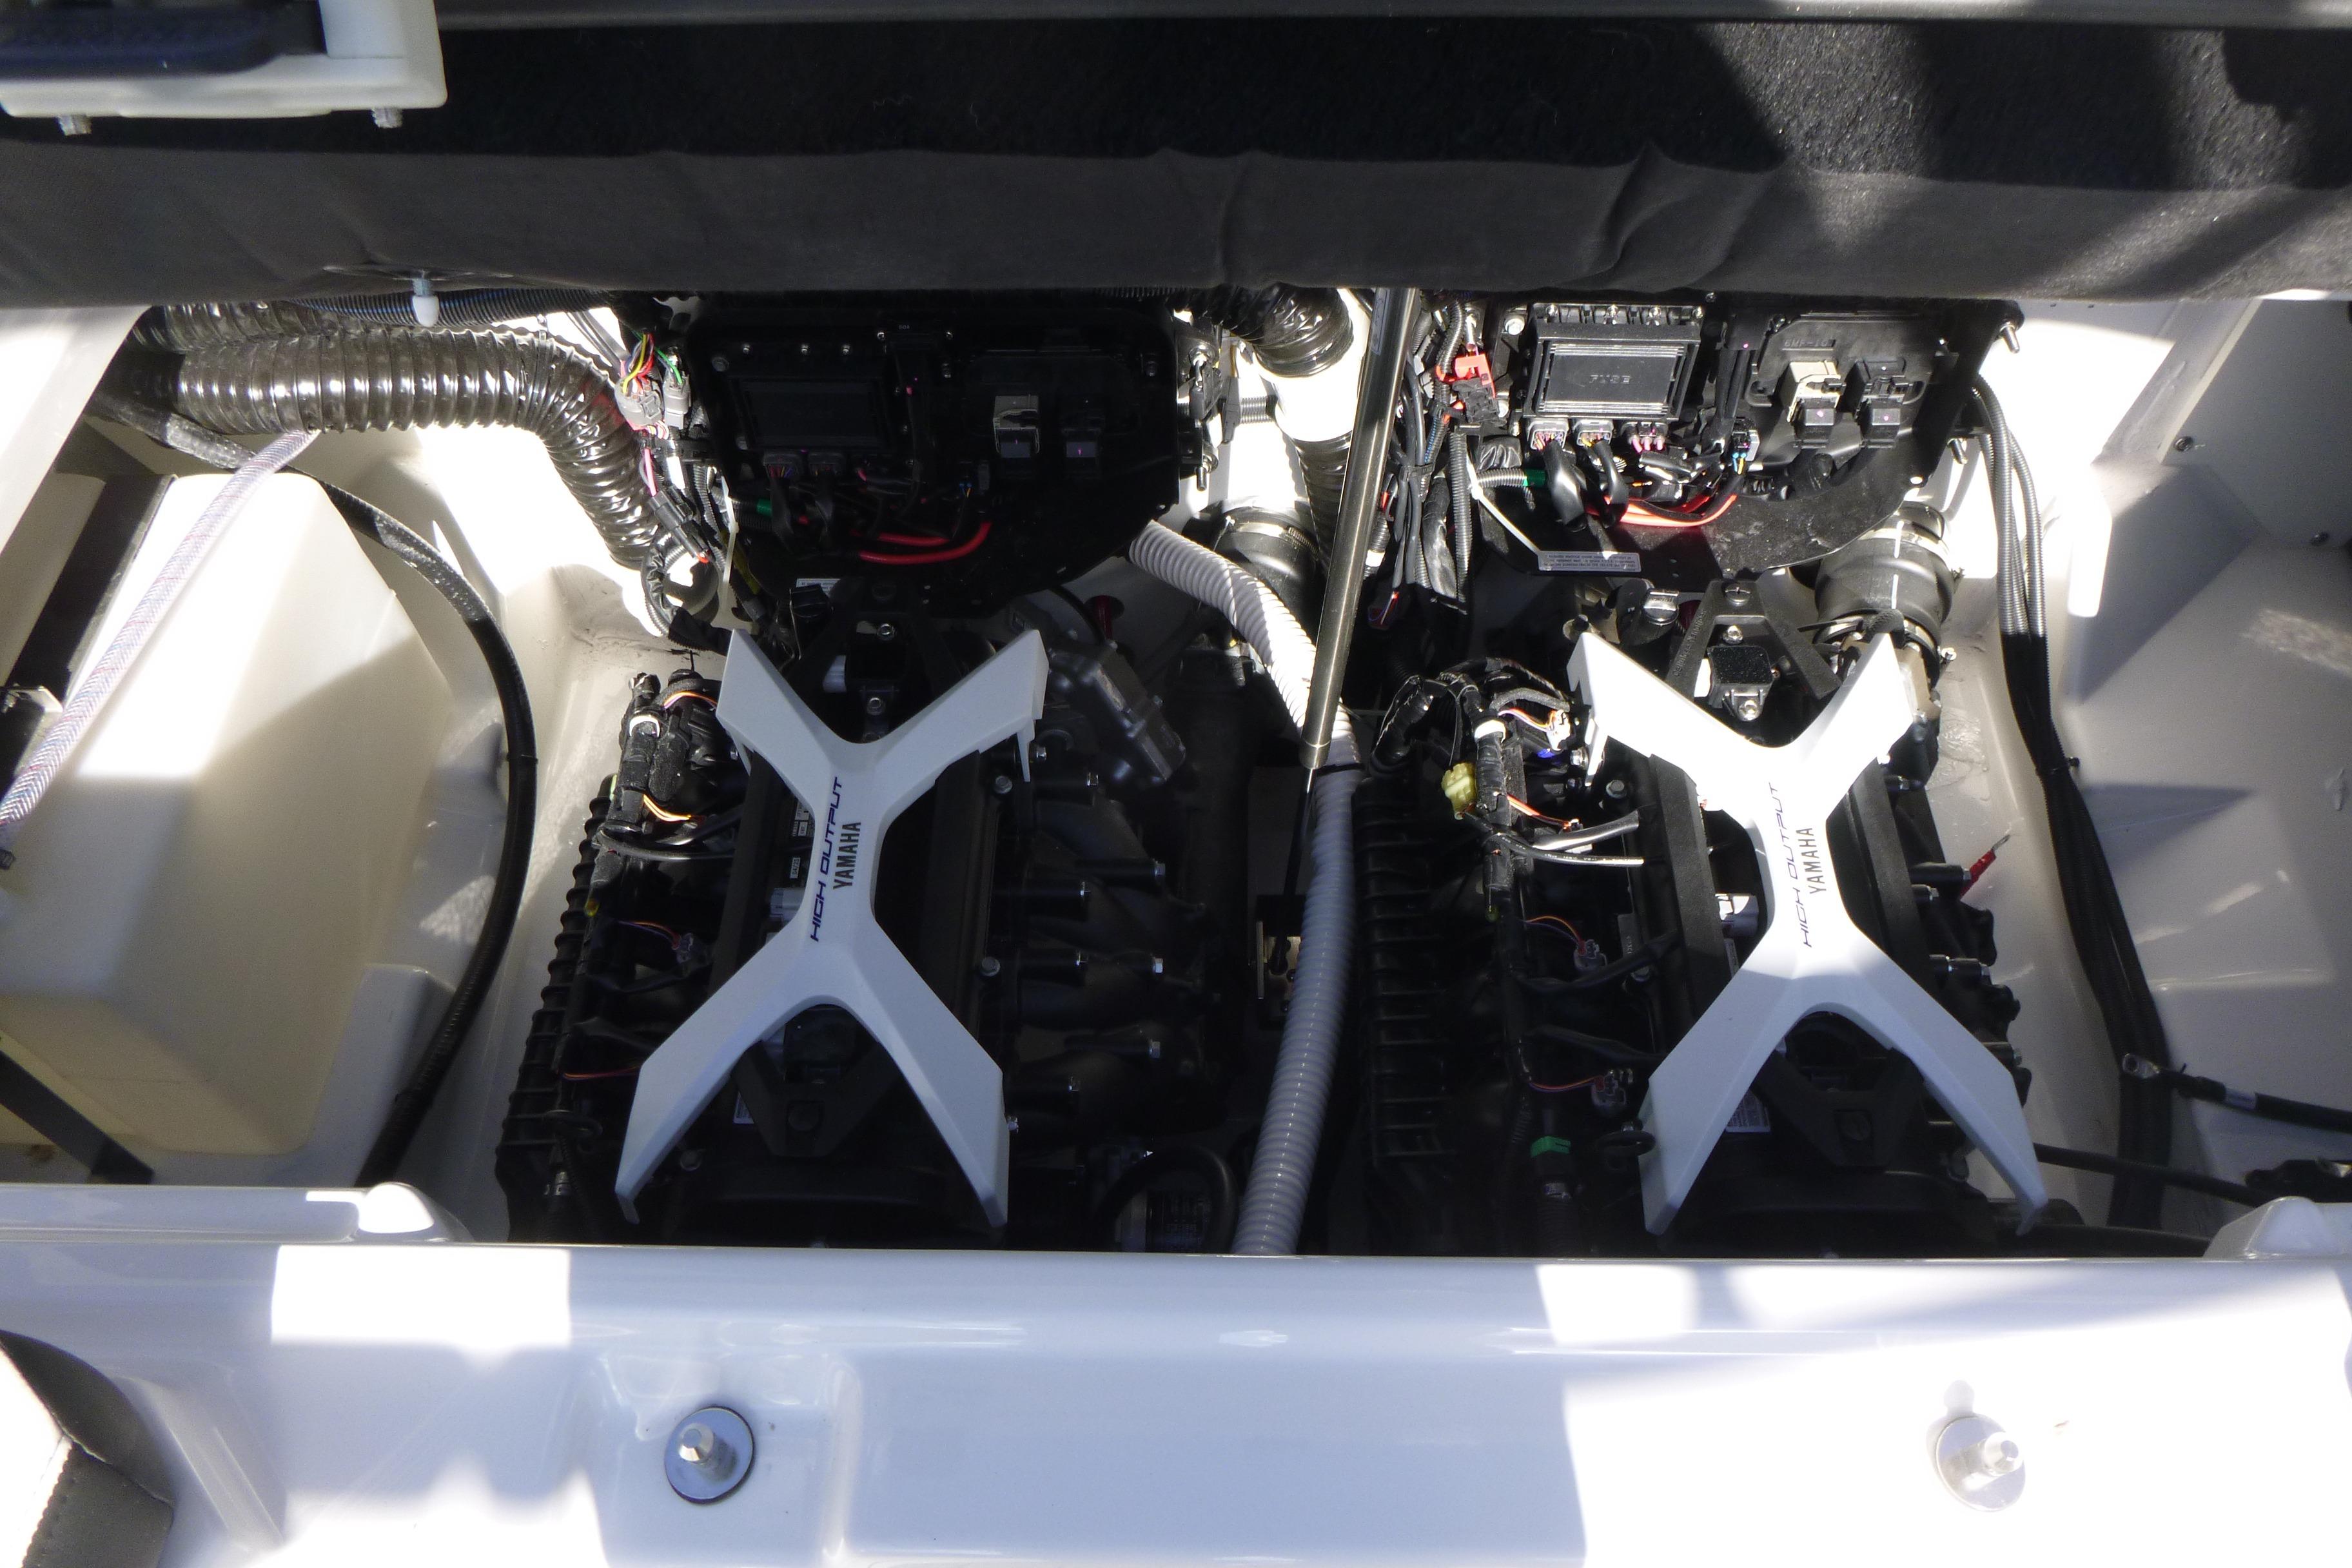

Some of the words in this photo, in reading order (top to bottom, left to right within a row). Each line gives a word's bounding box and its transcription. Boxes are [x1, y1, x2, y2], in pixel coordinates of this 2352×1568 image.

[810, 880, 827, 941] HIGH
[820, 776, 843, 875] OUTPUT
[833, 821, 861, 890] YAMAHA
[1769, 782, 1798, 879] OUTPUT
[1796, 828, 1827, 894] YAMAHA
[1792, 888, 1812, 948] HIGH
